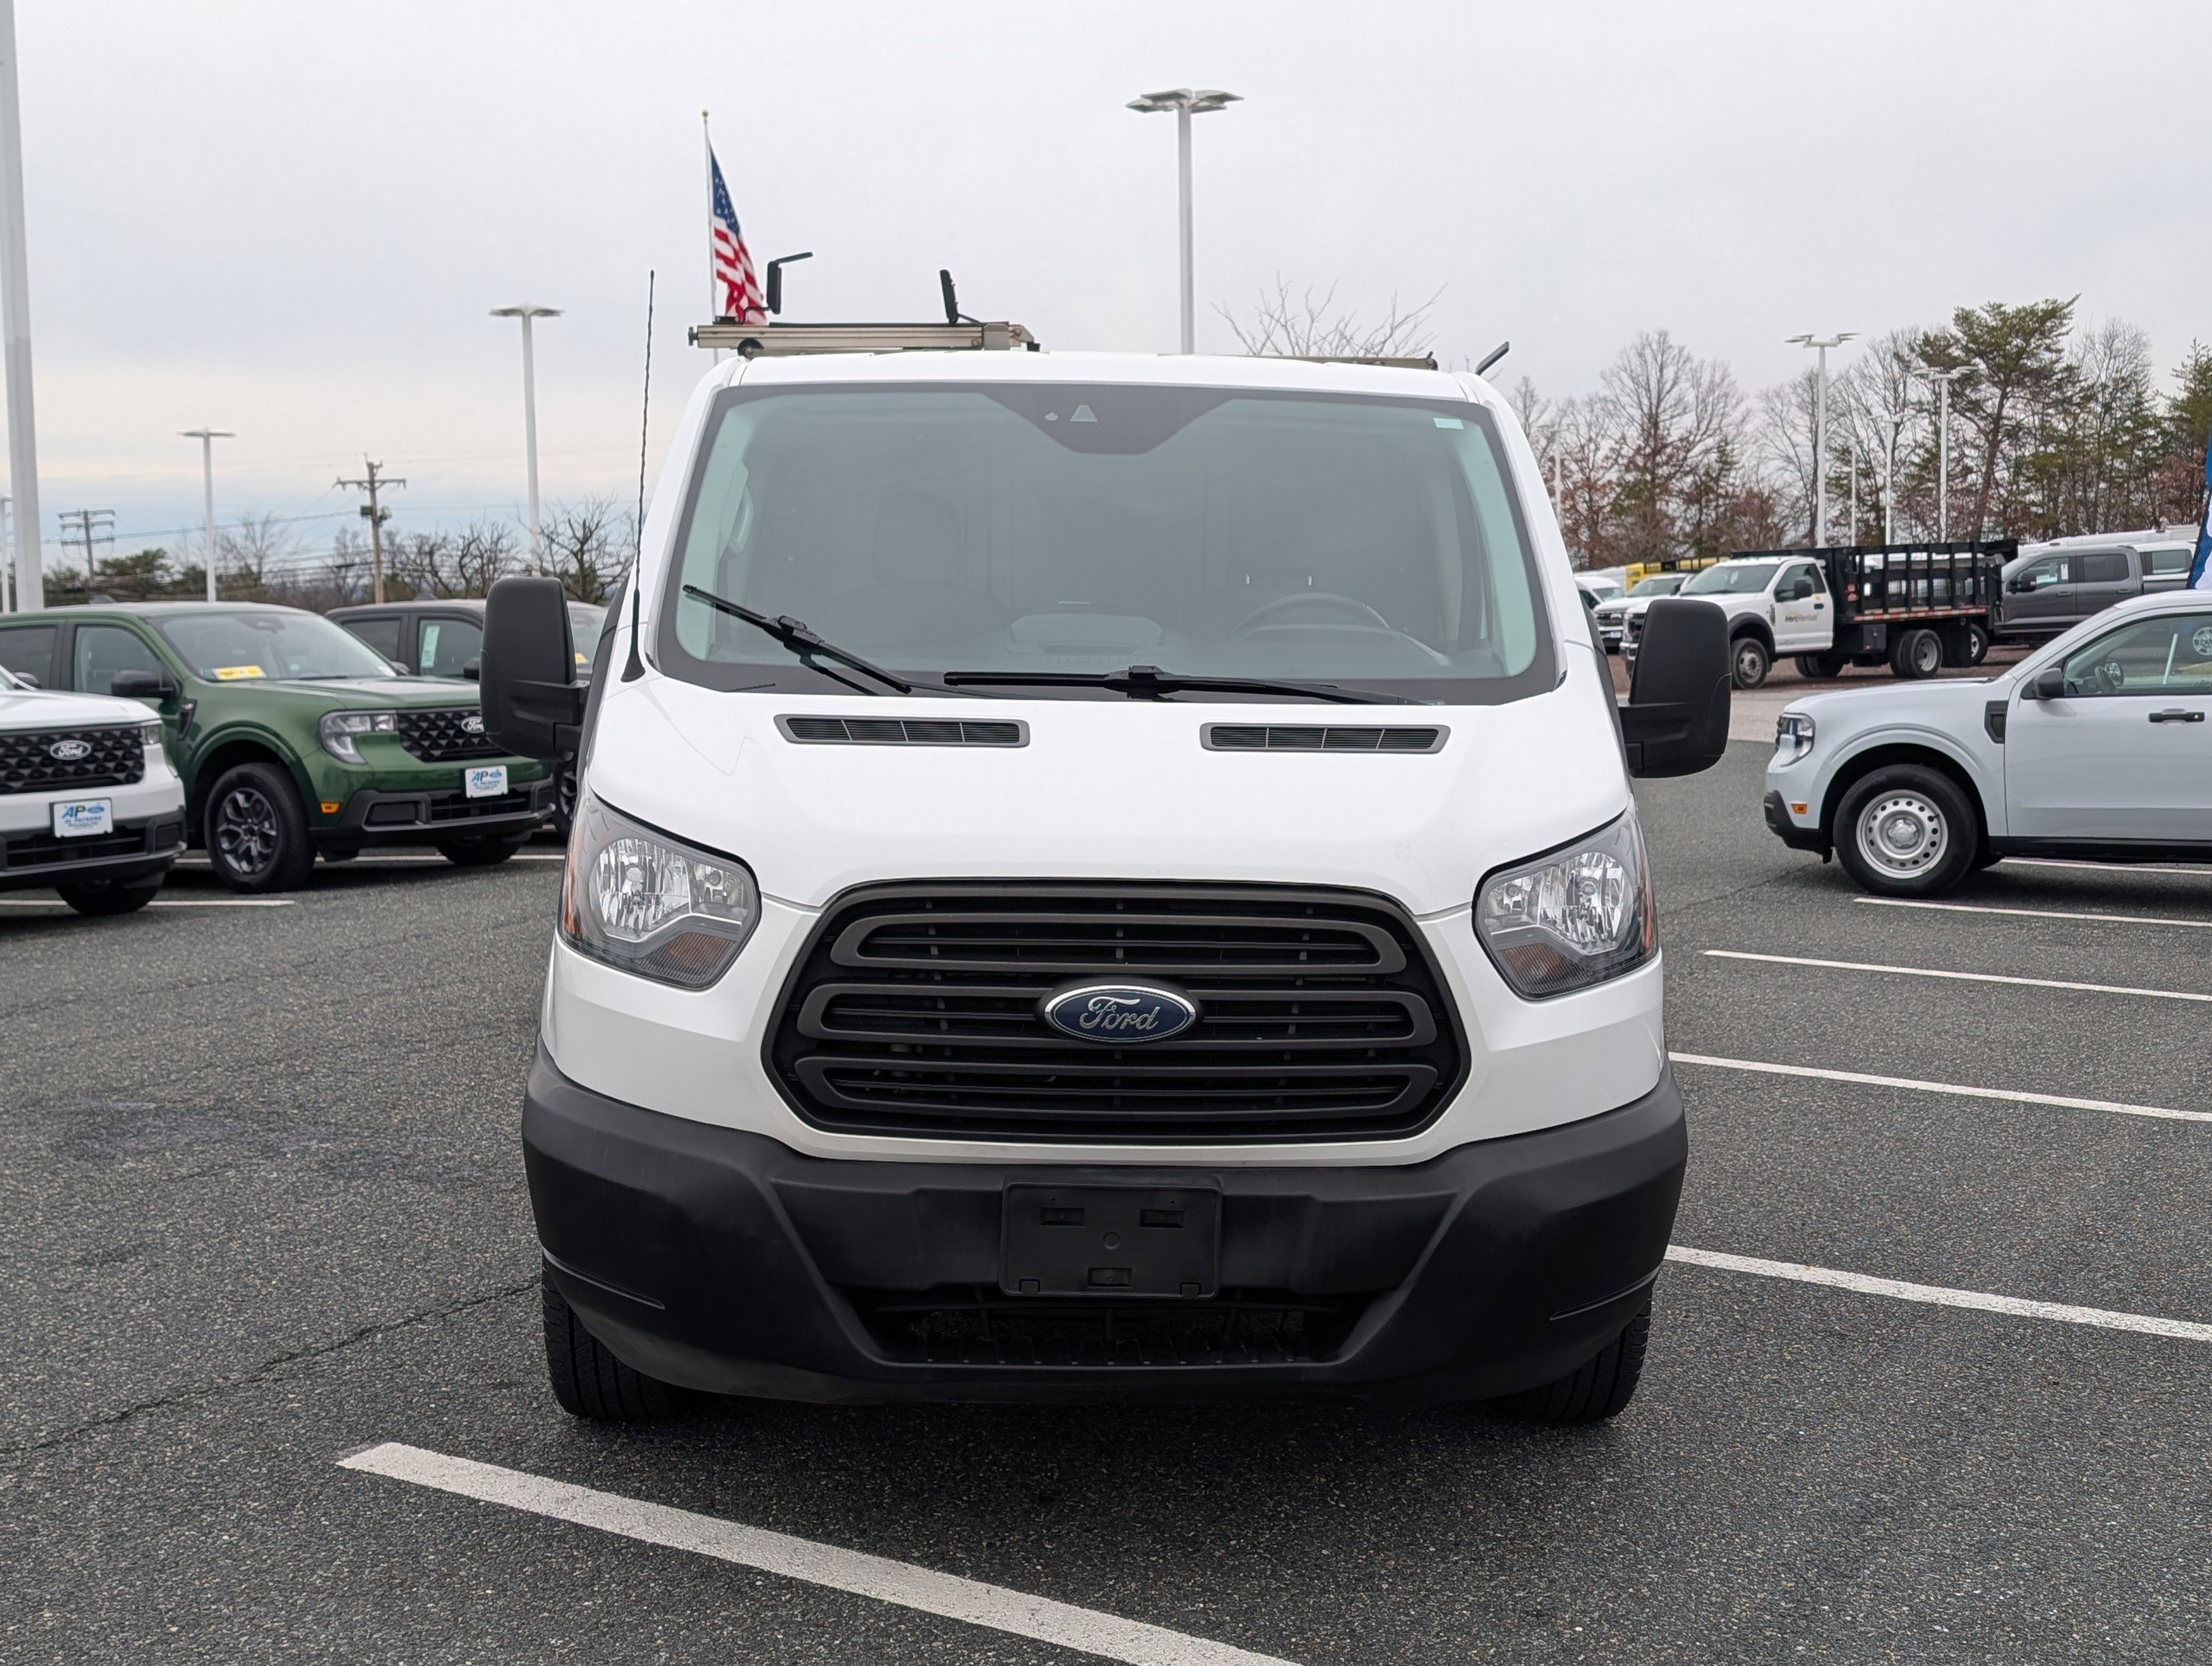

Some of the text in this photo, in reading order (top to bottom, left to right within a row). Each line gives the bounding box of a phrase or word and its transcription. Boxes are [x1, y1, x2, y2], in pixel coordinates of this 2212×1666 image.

[467, 719, 484, 731] For
[59, 743, 83, 757] Ford
[471, 771, 488, 783] AP
[62, 805, 86, 818] AP
[1079, 996, 1161, 1030] Ford
